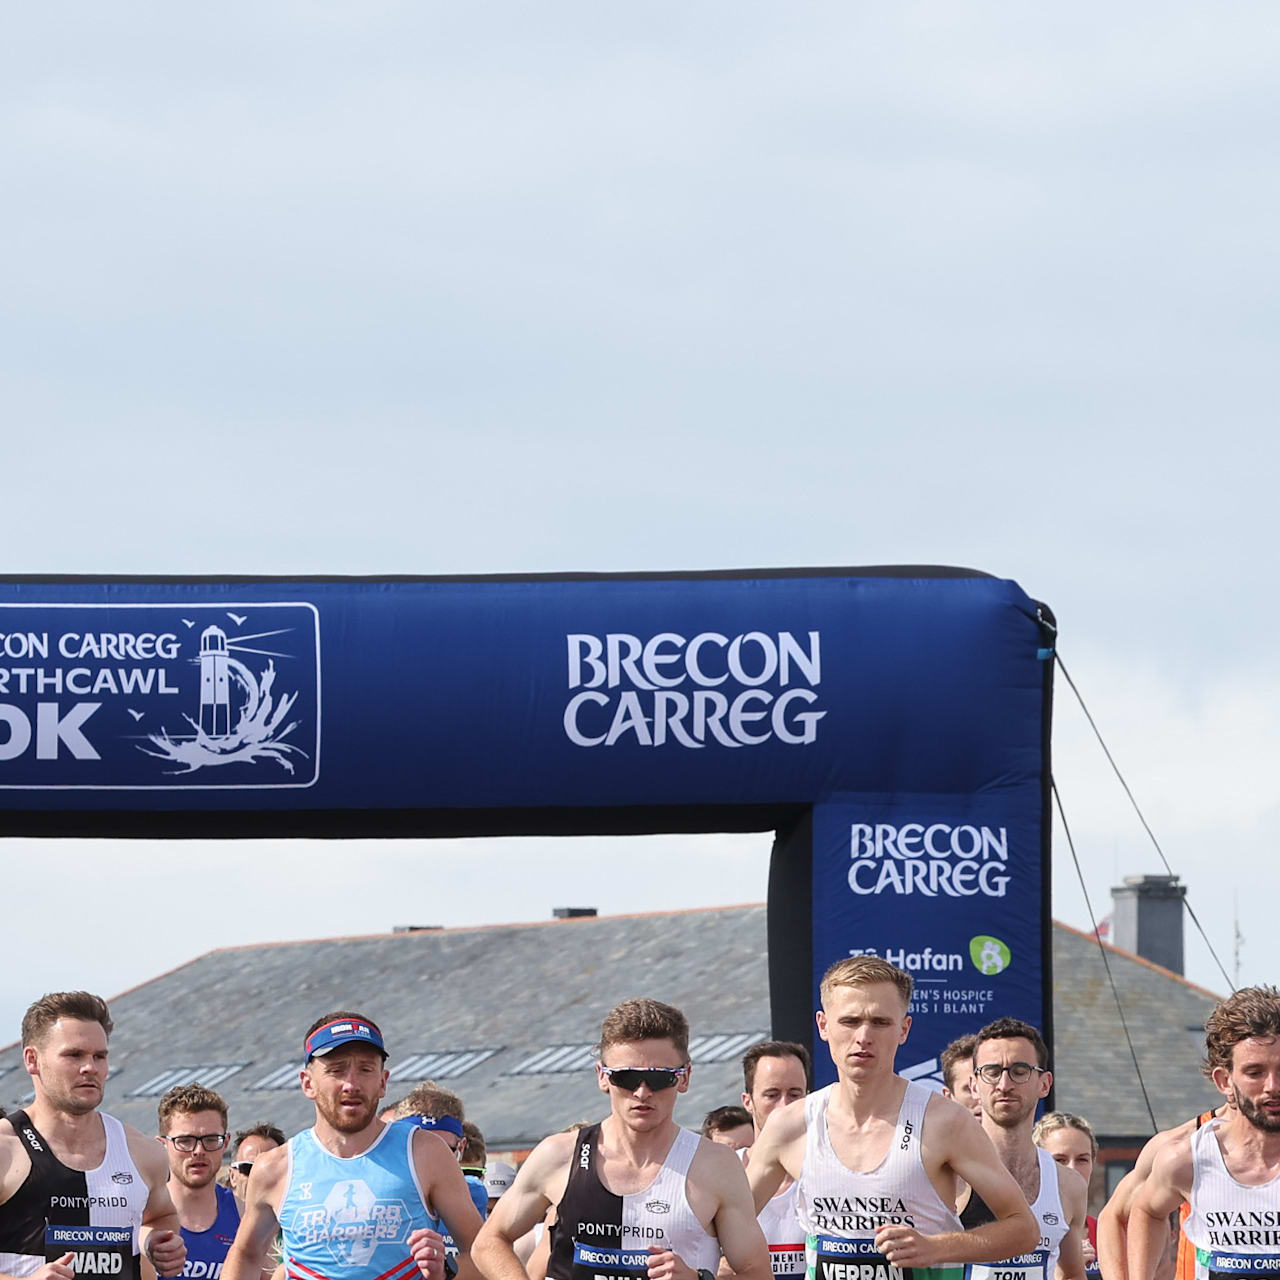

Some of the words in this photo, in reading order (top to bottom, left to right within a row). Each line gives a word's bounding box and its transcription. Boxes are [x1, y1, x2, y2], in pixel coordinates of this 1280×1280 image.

[59, 633, 181, 660] CARREG
[567, 631, 821, 690] BRECON
[563, 688, 827, 748] CARREG
[851, 823, 1008, 861] BRECON
[847, 859, 1011, 897] CARREG
[886, 947, 963, 971] Hafan
[943, 990, 993, 1000] HOSPICE
[944, 1003, 985, 1013] BLANT
[22, 1128, 44, 1153] soar
[900, 1120, 914, 1151] soar
[580, 1143, 591, 1170] soar
[50, 1196, 128, 1208] PONTYPRIDD
[813, 1197, 908, 1213] SWANSEA
[53, 1230, 94, 1242] BRECON
[95, 1230, 131, 1242] CARREG
[577, 1222, 664, 1239] PONTYPRIDD
[822, 1240, 858, 1254] BRECON
[580, 1250, 620, 1265] BRECON
[621, 1253, 648, 1266] CARR
[1012, 1254, 1043, 1264] CARREG
[1216, 1256, 1252, 1270] BRECON
